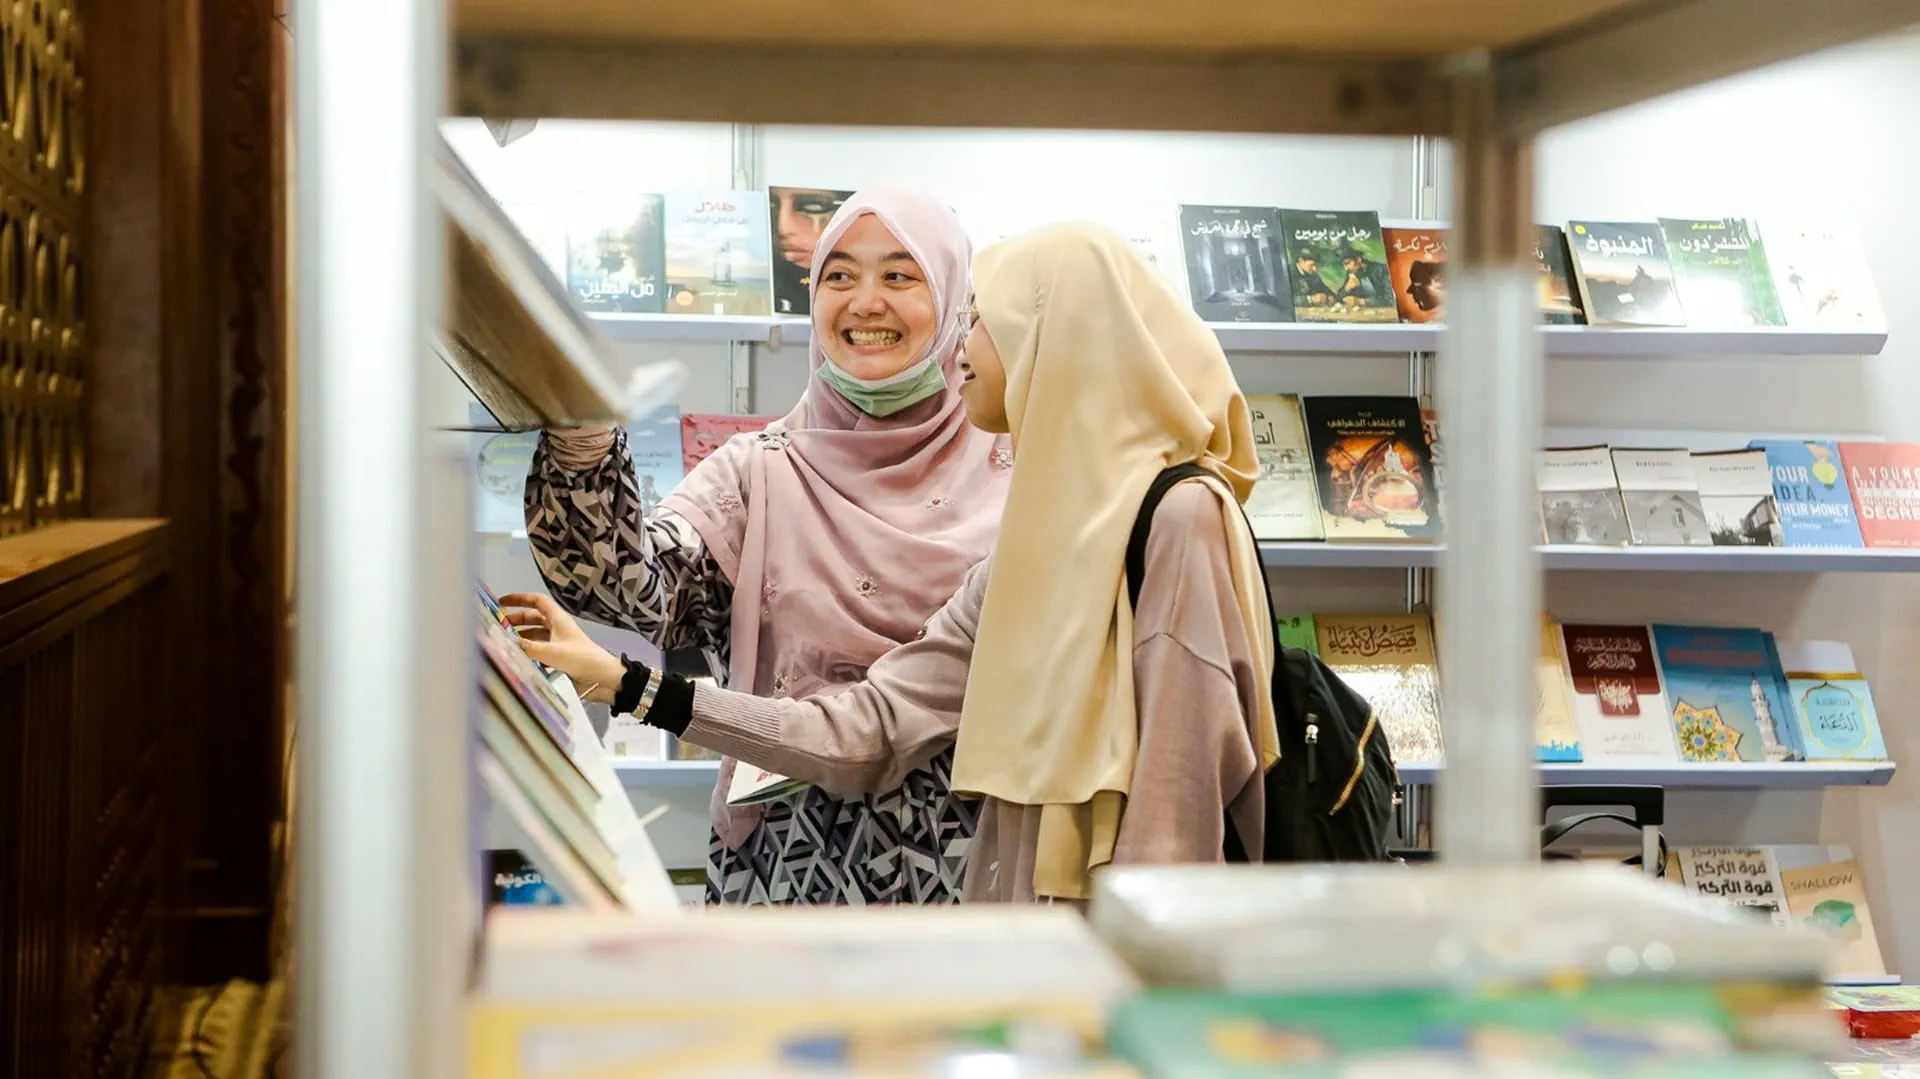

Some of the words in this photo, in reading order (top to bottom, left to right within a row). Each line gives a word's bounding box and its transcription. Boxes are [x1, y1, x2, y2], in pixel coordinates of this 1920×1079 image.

[1810, 503, 1849, 517] MONEY
[1863, 504, 1920, 520] DEGRE
[1739, 861, 1767, 876] قوة
[1744, 880, 1774, 896] قوة
[1789, 872, 1854, 890] SHALLOW
